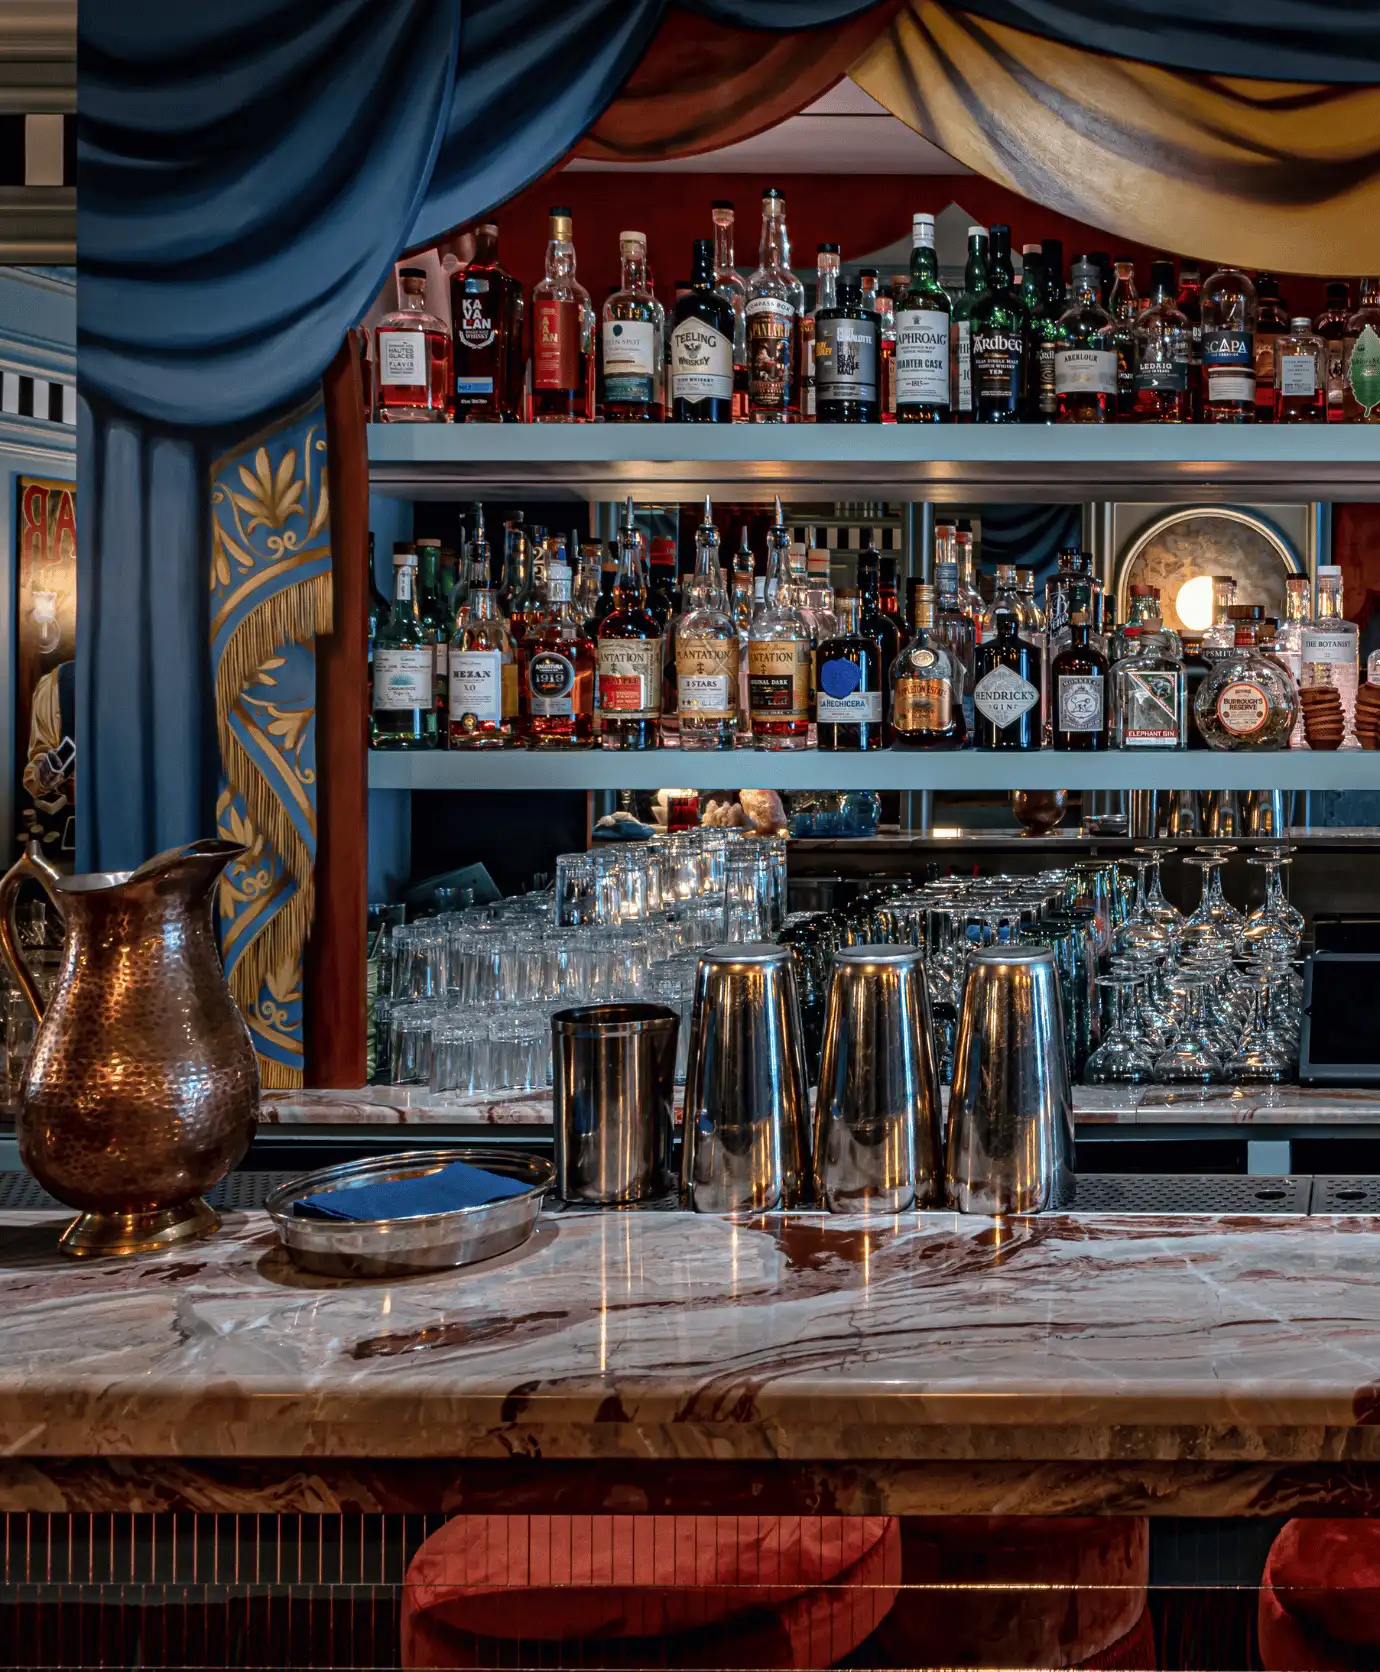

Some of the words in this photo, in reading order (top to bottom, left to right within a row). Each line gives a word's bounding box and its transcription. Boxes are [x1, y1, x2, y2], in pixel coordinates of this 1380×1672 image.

[462, 300, 483, 310] KA
[777, 302, 792, 313] BOX
[463, 310, 482, 320] VA
[462, 319, 492, 330] LAN
[675, 332, 717, 347] TEELING
[896, 332, 948, 345] APHROAIG
[1204, 337, 1249, 353] SCAPA
[678, 357, 710, 367] WHISKEY
[1063, 352, 1099, 363] ABERLOUR
[896, 359, 922, 371] UARTER
[924, 359, 943, 370] CASK
[1139, 363, 1173, 371] LEDAIG
[1318, 640, 1352, 648] BOTANIST
[598, 651, 644, 664] ANTATION
[682, 651, 732, 663] ANTATION
[750, 652, 794, 663] ANTATION
[452, 670, 492, 679] MEZAN
[535, 672, 565, 684] 1919
[685, 680, 691, 688] 3
[691, 680, 718, 688] STARS
[771, 679, 789, 687] DARK
[975, 691, 1036, 701] HENDRICK'S
[1223, 697, 1264, 705] BURROUGH'S
[826, 699, 866, 709] HECHICERA
[992, 703, 1014, 711] GIN
